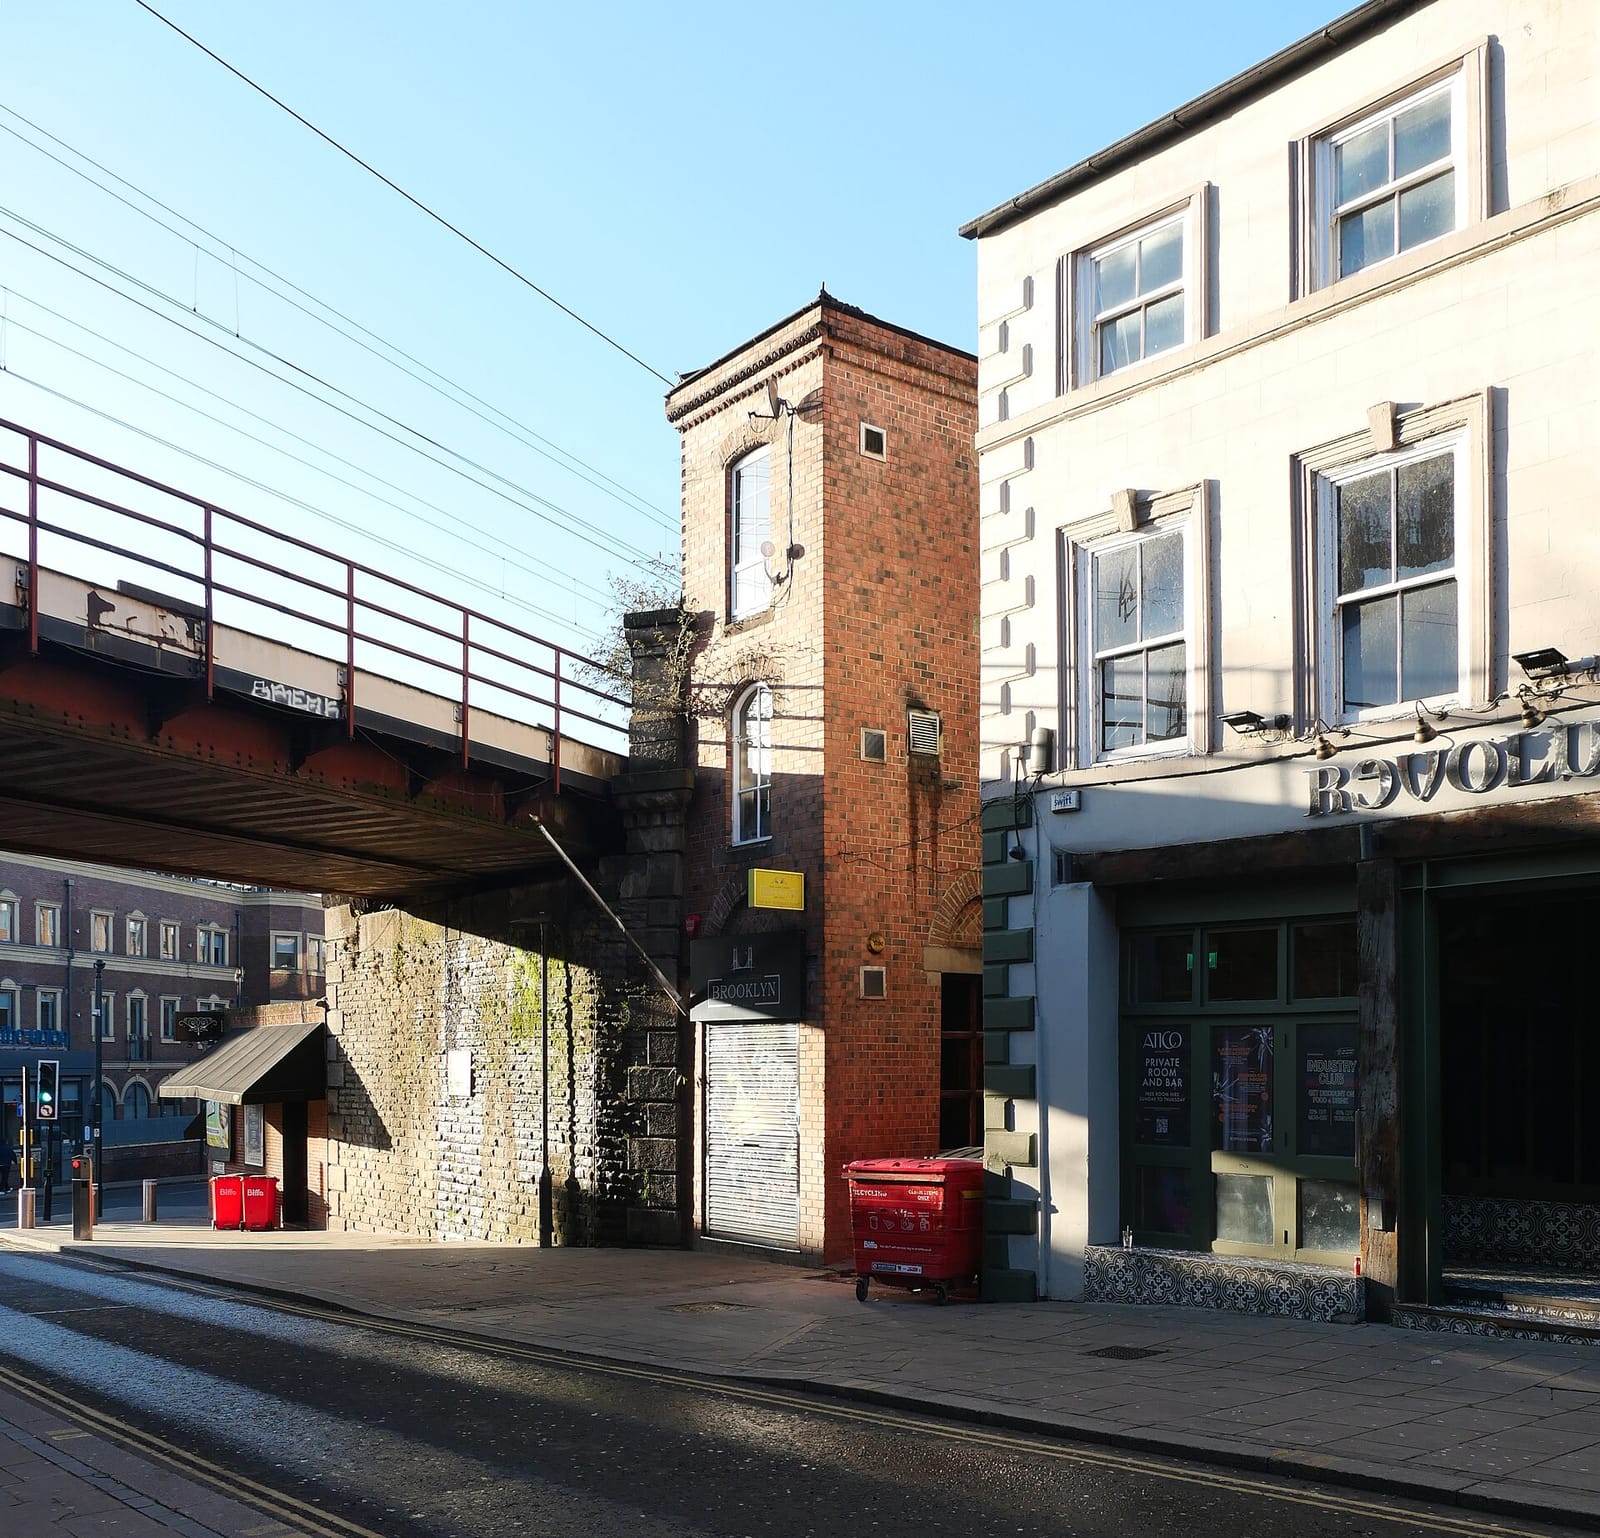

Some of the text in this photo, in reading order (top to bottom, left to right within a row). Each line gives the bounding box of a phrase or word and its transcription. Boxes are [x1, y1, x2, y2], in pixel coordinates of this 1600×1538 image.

[712, 981, 776, 1000] BROOKLYN
[1142, 1031, 1183, 1049] ATICO
[1145, 1058, 1180, 1067] PRIVATE
[1306, 1060, 1358, 1073] INDUSTRY
[1147, 1068, 1177, 1077] ROOM
[1142, 1078, 1183, 1088] AND BAR
[1318, 1073, 1345, 1086] CLUB
[247, 1188, 265, 1197] Biffa
